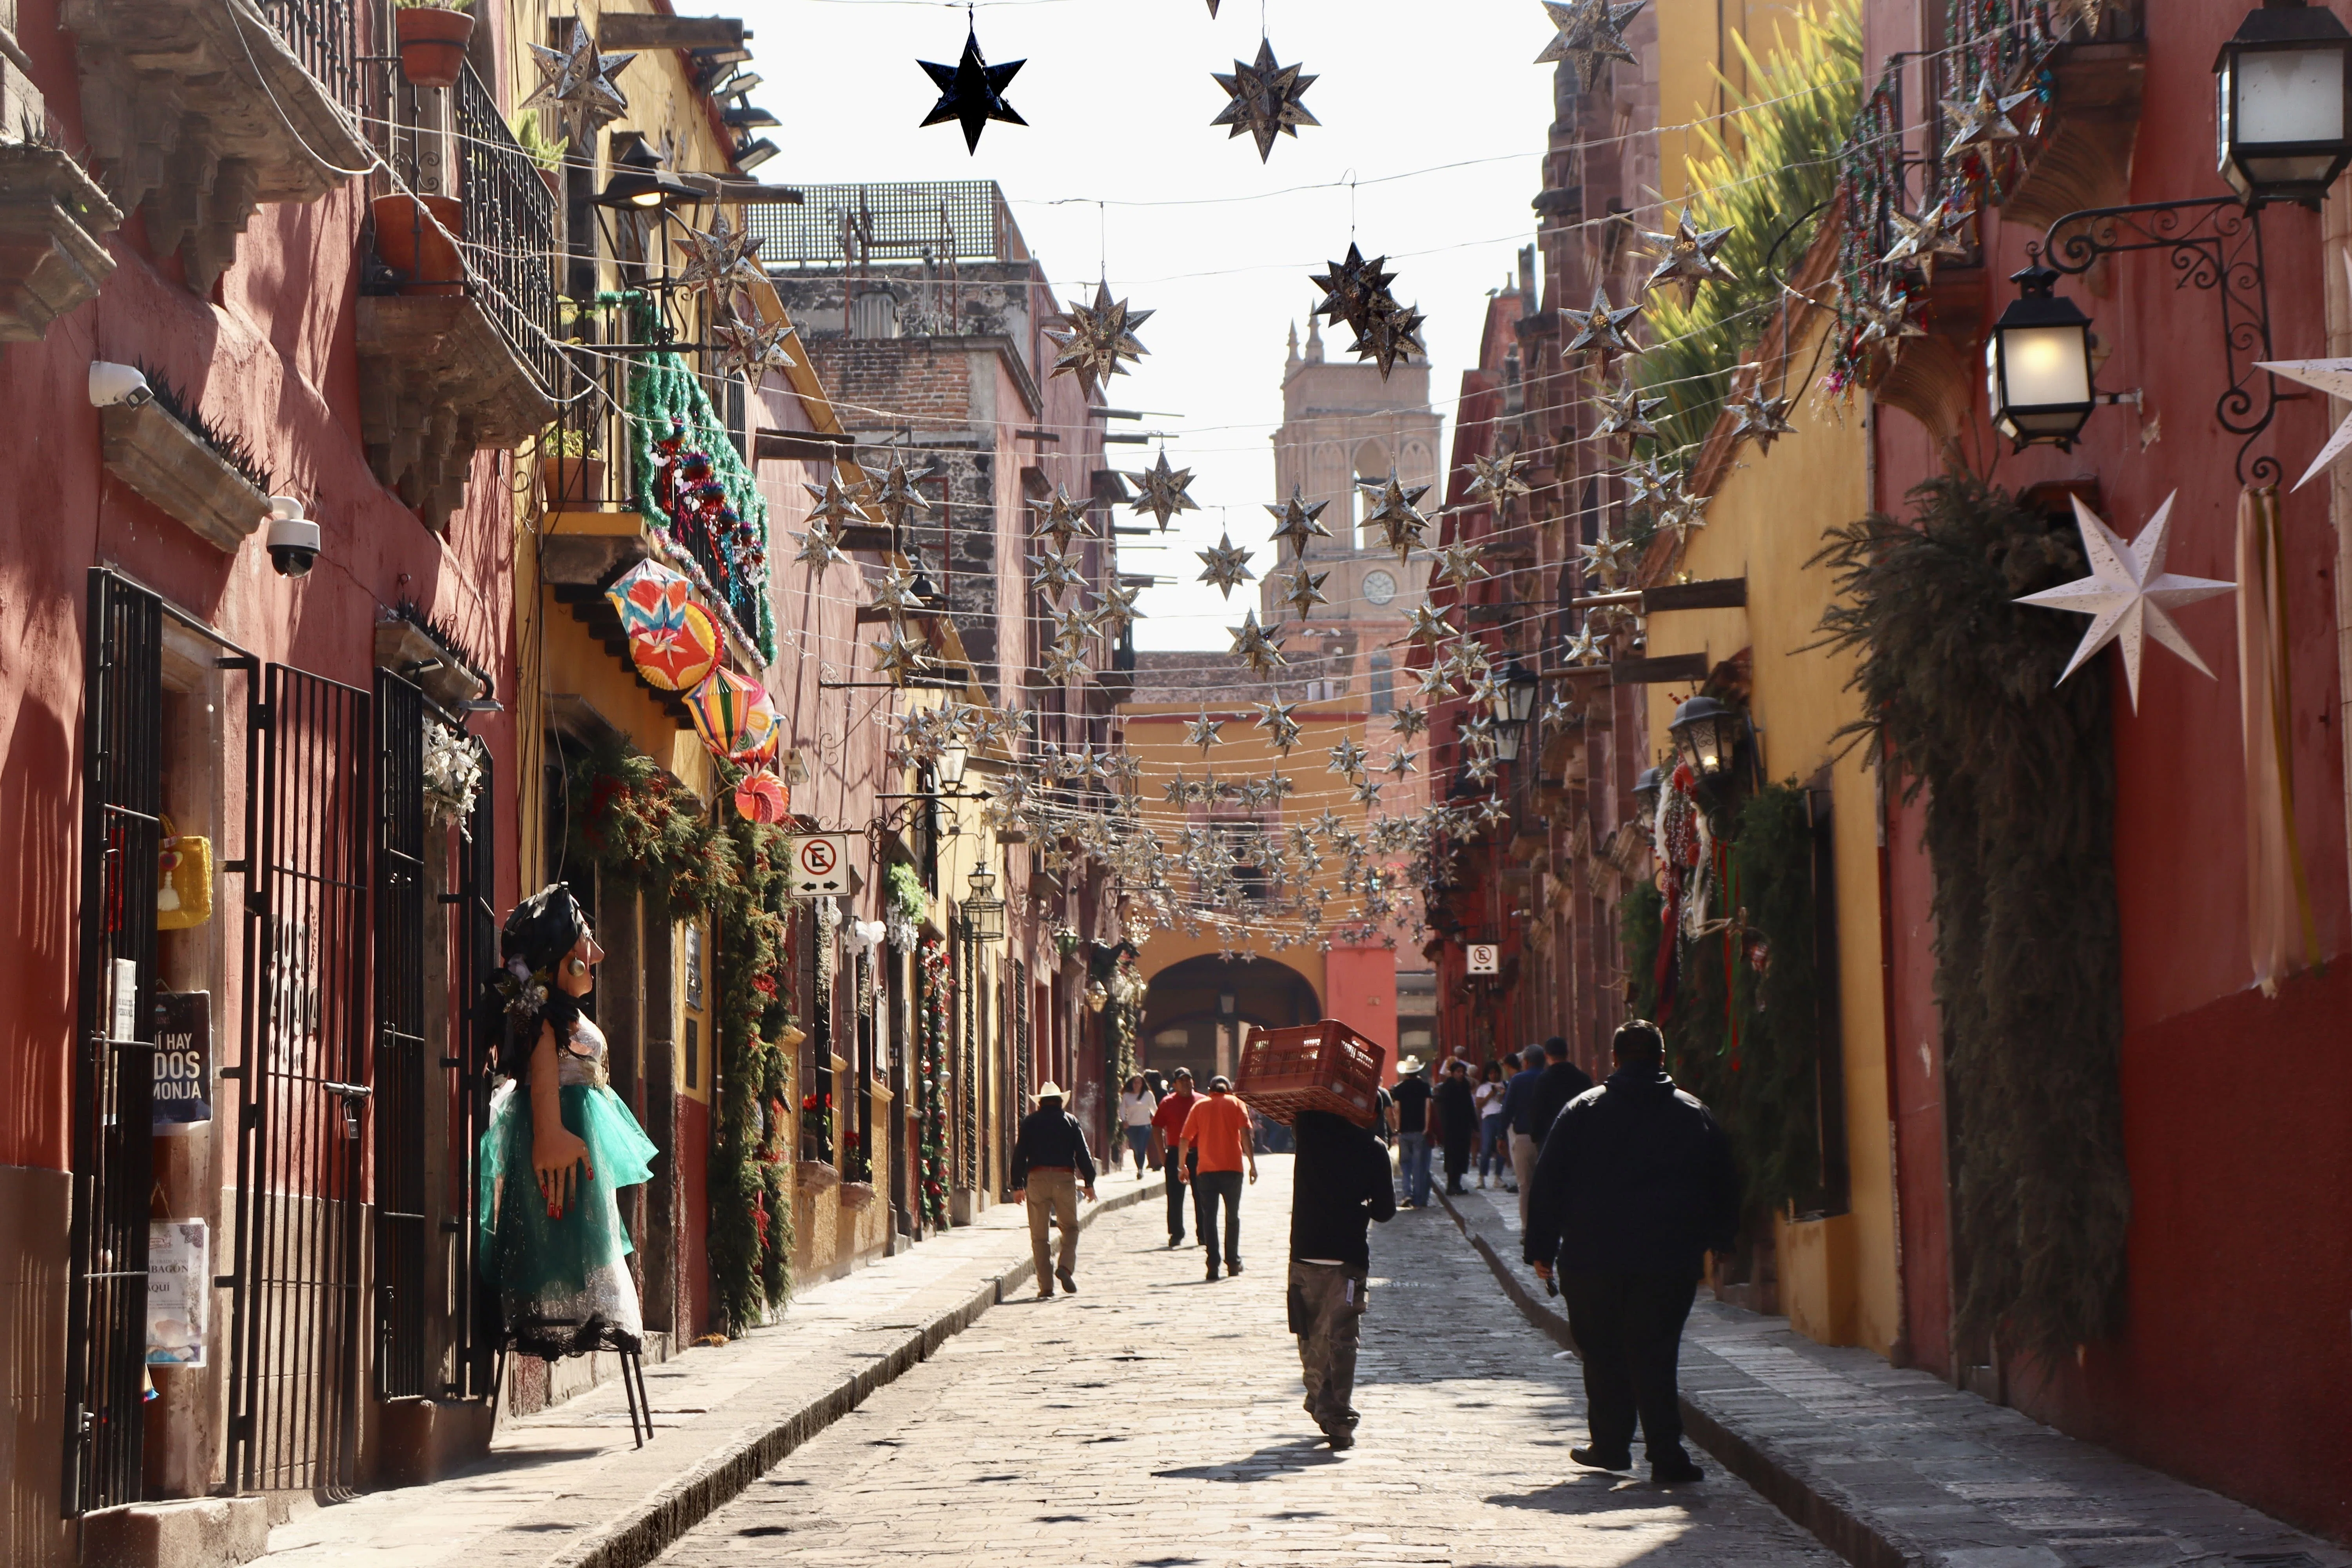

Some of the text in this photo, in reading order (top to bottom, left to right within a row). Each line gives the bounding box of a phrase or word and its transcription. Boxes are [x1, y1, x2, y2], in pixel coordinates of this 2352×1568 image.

[811, 848, 826, 867] E
[167, 1033, 192, 1050] HAY
[154, 1051, 200, 1080] DOS
[149, 1263, 188, 1274] BAGÓN
